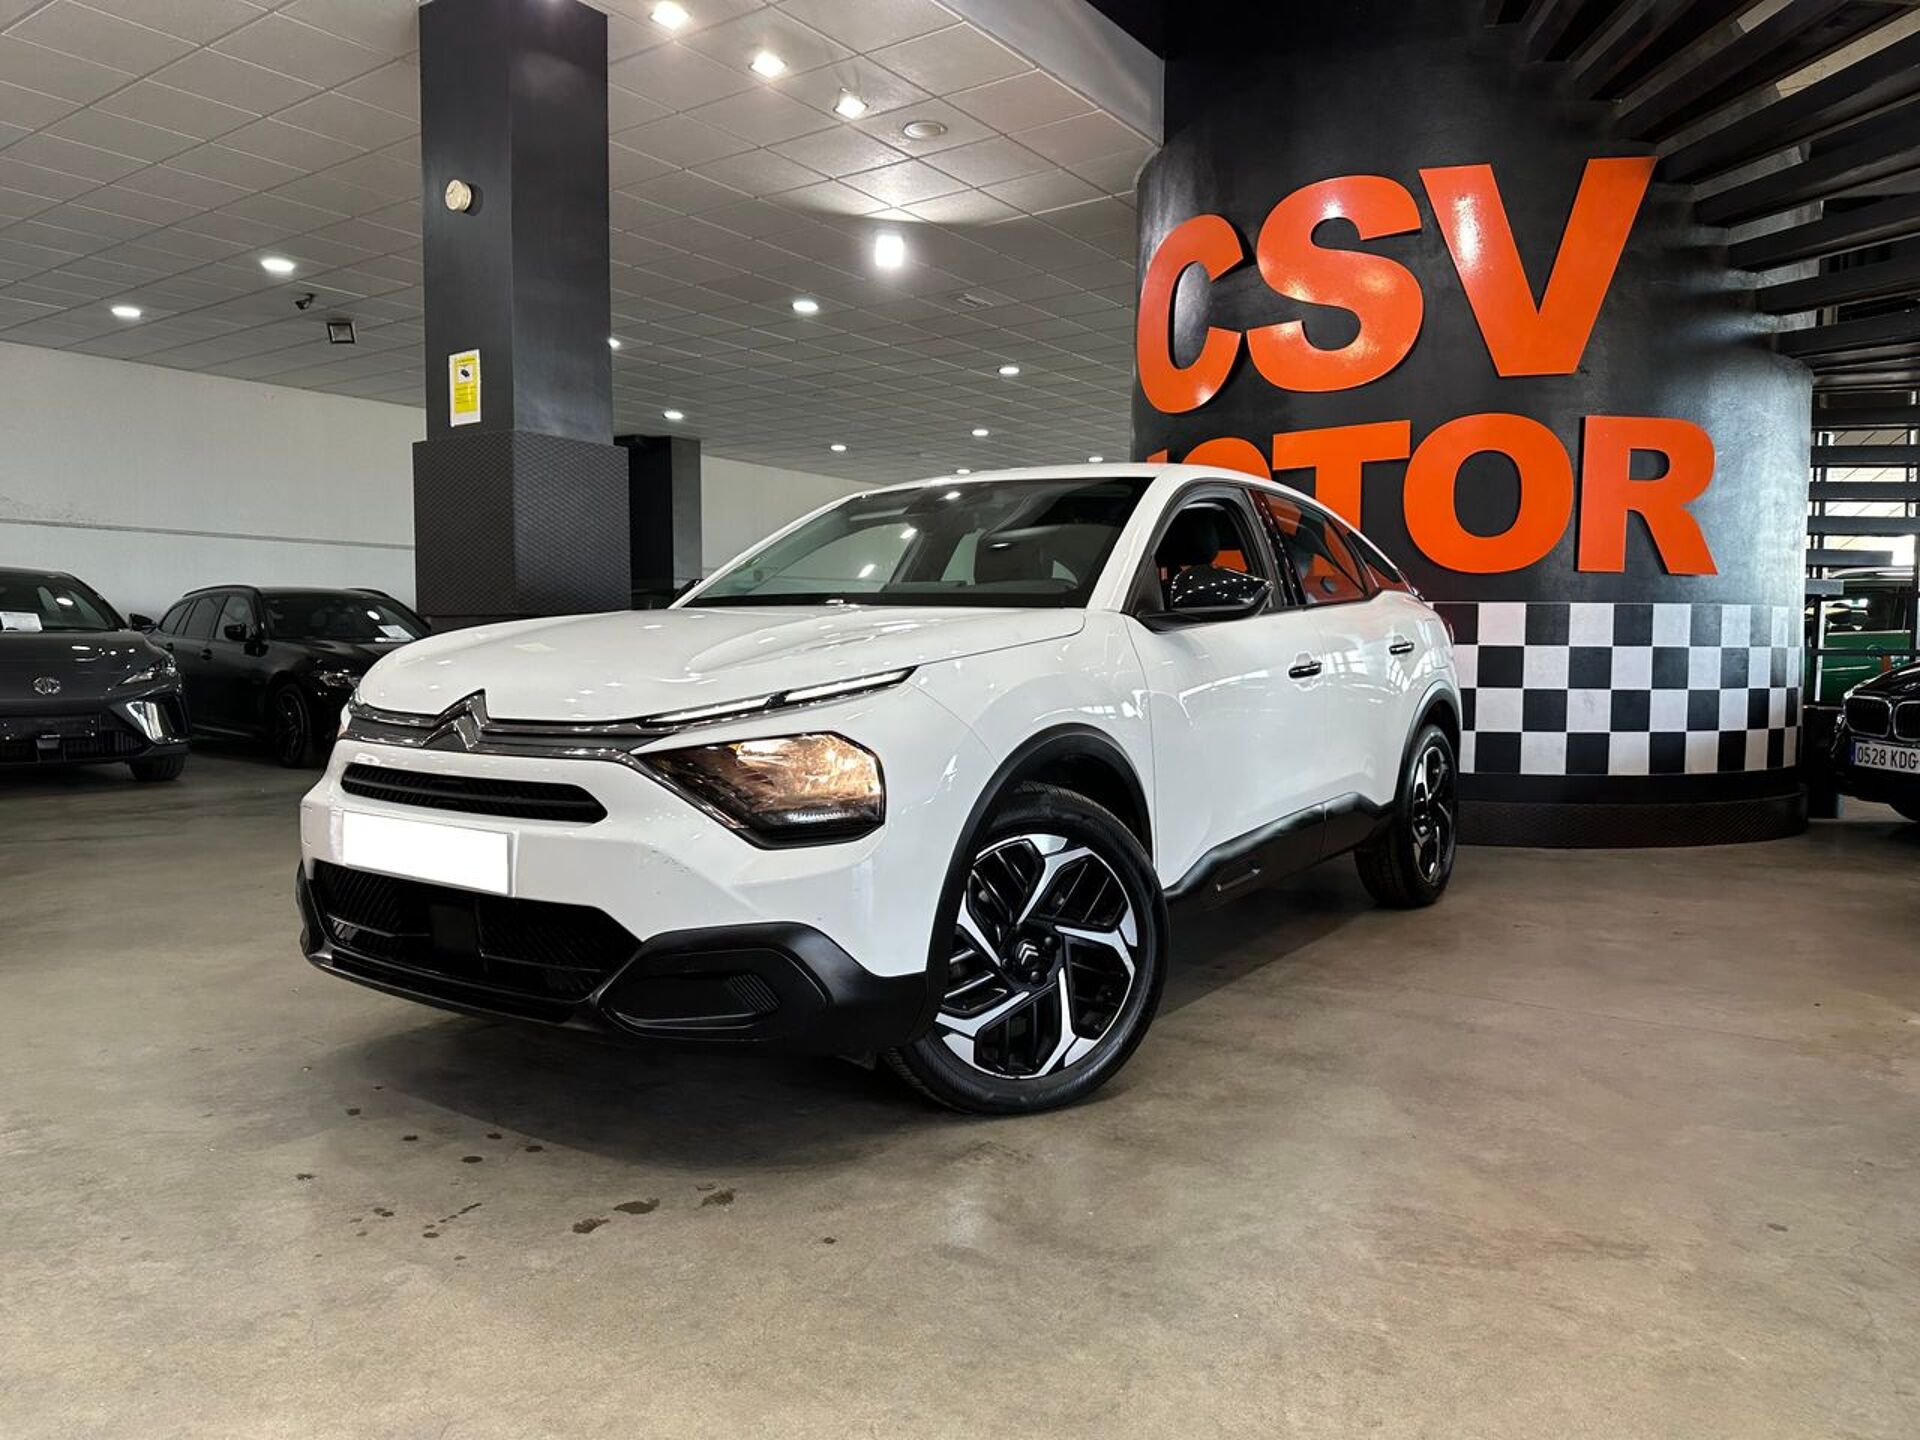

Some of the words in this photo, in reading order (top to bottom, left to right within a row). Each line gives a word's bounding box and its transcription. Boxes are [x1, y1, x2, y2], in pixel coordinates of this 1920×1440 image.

[1137, 156, 1655, 413] CSV
[1147, 413, 1717, 575] TOR
[1857, 746, 1886, 766] 0528
[1891, 750, 1918, 769] KDG
